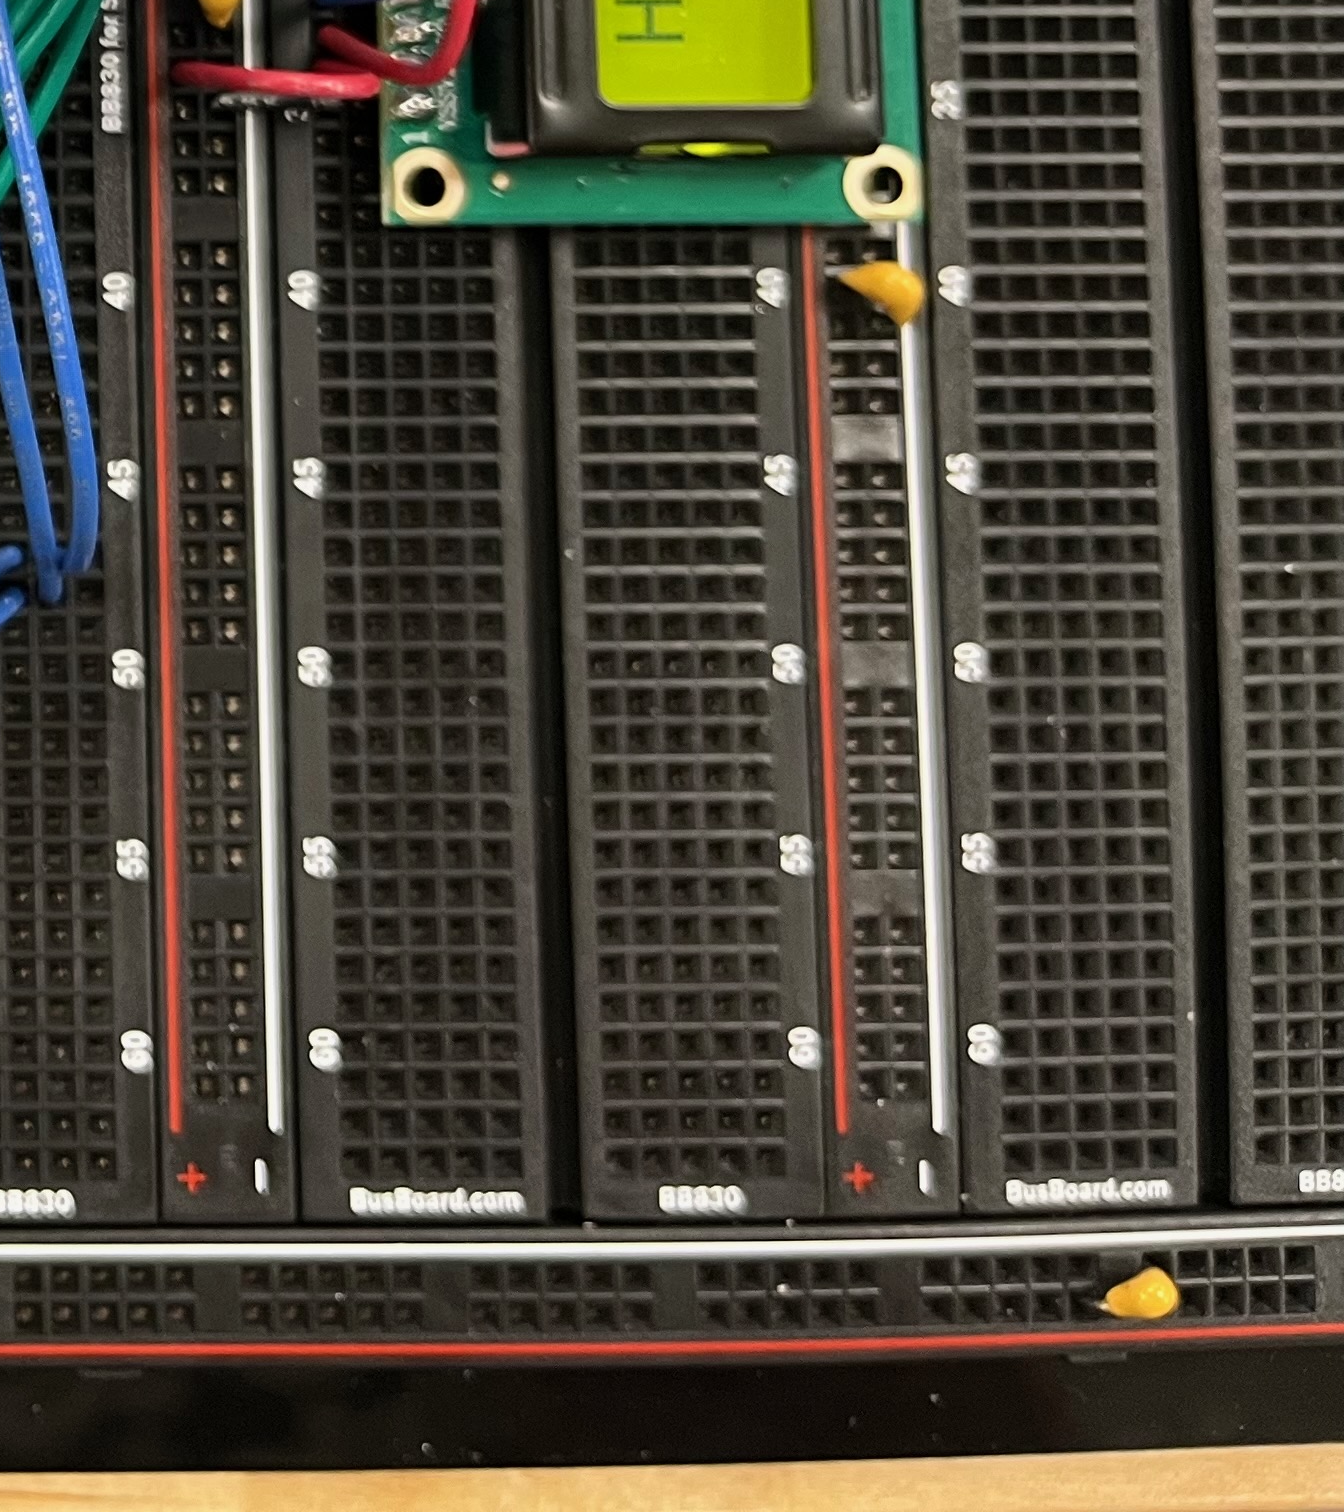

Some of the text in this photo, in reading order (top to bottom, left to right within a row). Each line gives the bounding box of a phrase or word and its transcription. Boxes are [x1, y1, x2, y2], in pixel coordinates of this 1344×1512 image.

[101, 271, 136, 311] 40
[106, 458, 140, 501] 45
[112, 648, 146, 688] 50
[297, 645, 332, 687] 50
[116, 838, 149, 881] 55
[120, 1029, 154, 1074] 60
[308, 1027, 343, 1072] 60
[349, 1185, 528, 1218] BusBoard.com
[1005, 1177, 1172, 1205] BusBoard.com
[1298, 1169, 1344, 1194] BB8
